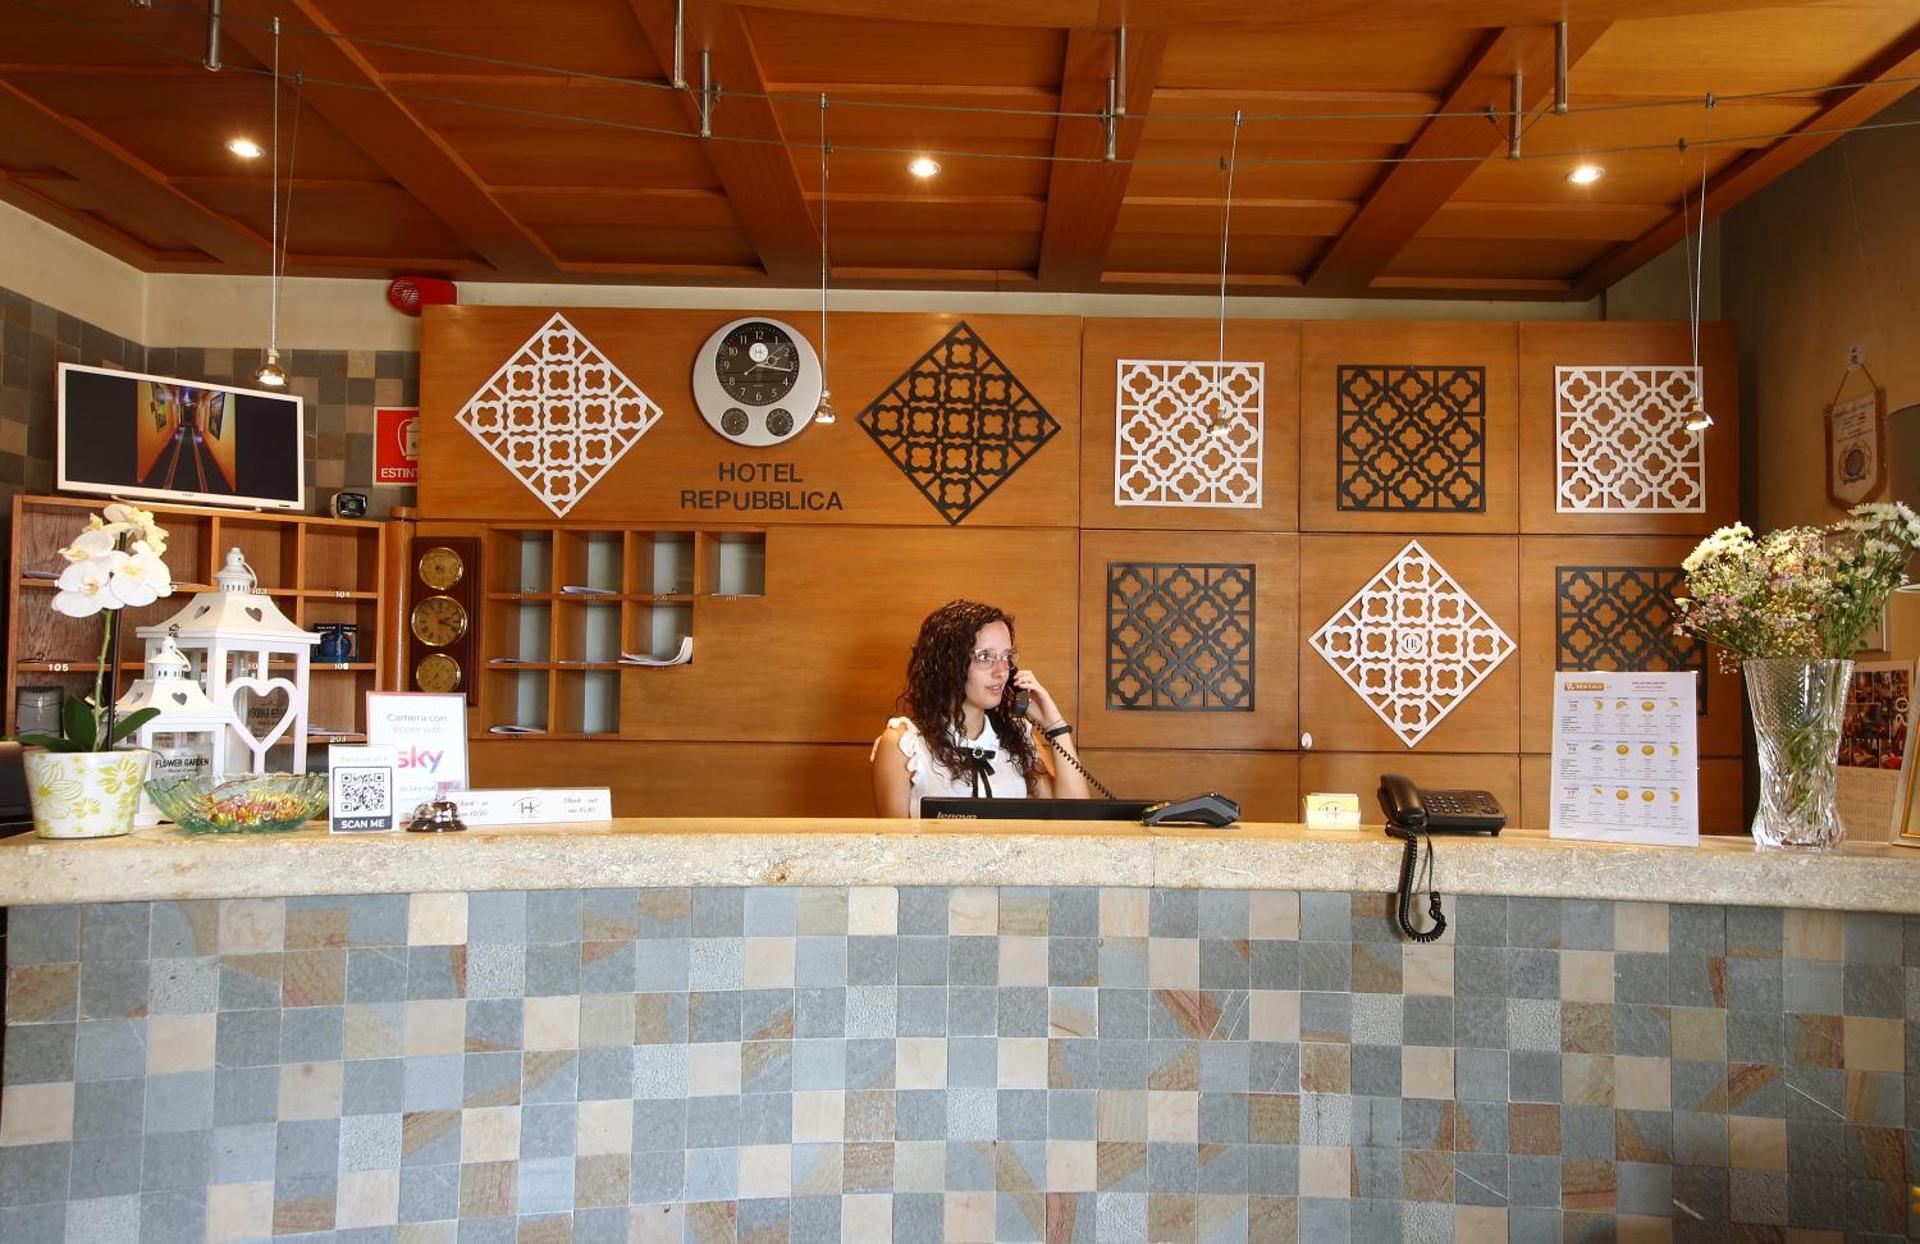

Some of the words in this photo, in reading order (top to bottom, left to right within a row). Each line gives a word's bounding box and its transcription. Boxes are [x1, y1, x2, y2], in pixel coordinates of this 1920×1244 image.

[740, 335, 747, 344] 11
[755, 330, 764, 340] 12
[728, 347, 738, 356] 10
[784, 347, 790, 357] 2
[723, 360, 730, 370] 9
[728, 376, 736, 386] 8
[782, 377, 789, 387] 4
[740, 387, 746, 397] 7
[755, 392, 762, 401] 6
[771, 388, 778, 398] 5
[718, 462, 803, 483] HOTEL
[680, 489, 844, 512] REPUBBLICA
[48, 663, 69, 672] 105
[387, 713, 427, 722] Camera
[155, 758, 183, 769] FLOWER
[184, 756, 210, 767] GARDEN
[397, 744, 445, 774] sky
[341, 819, 368, 829] SCAN
[370, 818, 385, 828] ME
